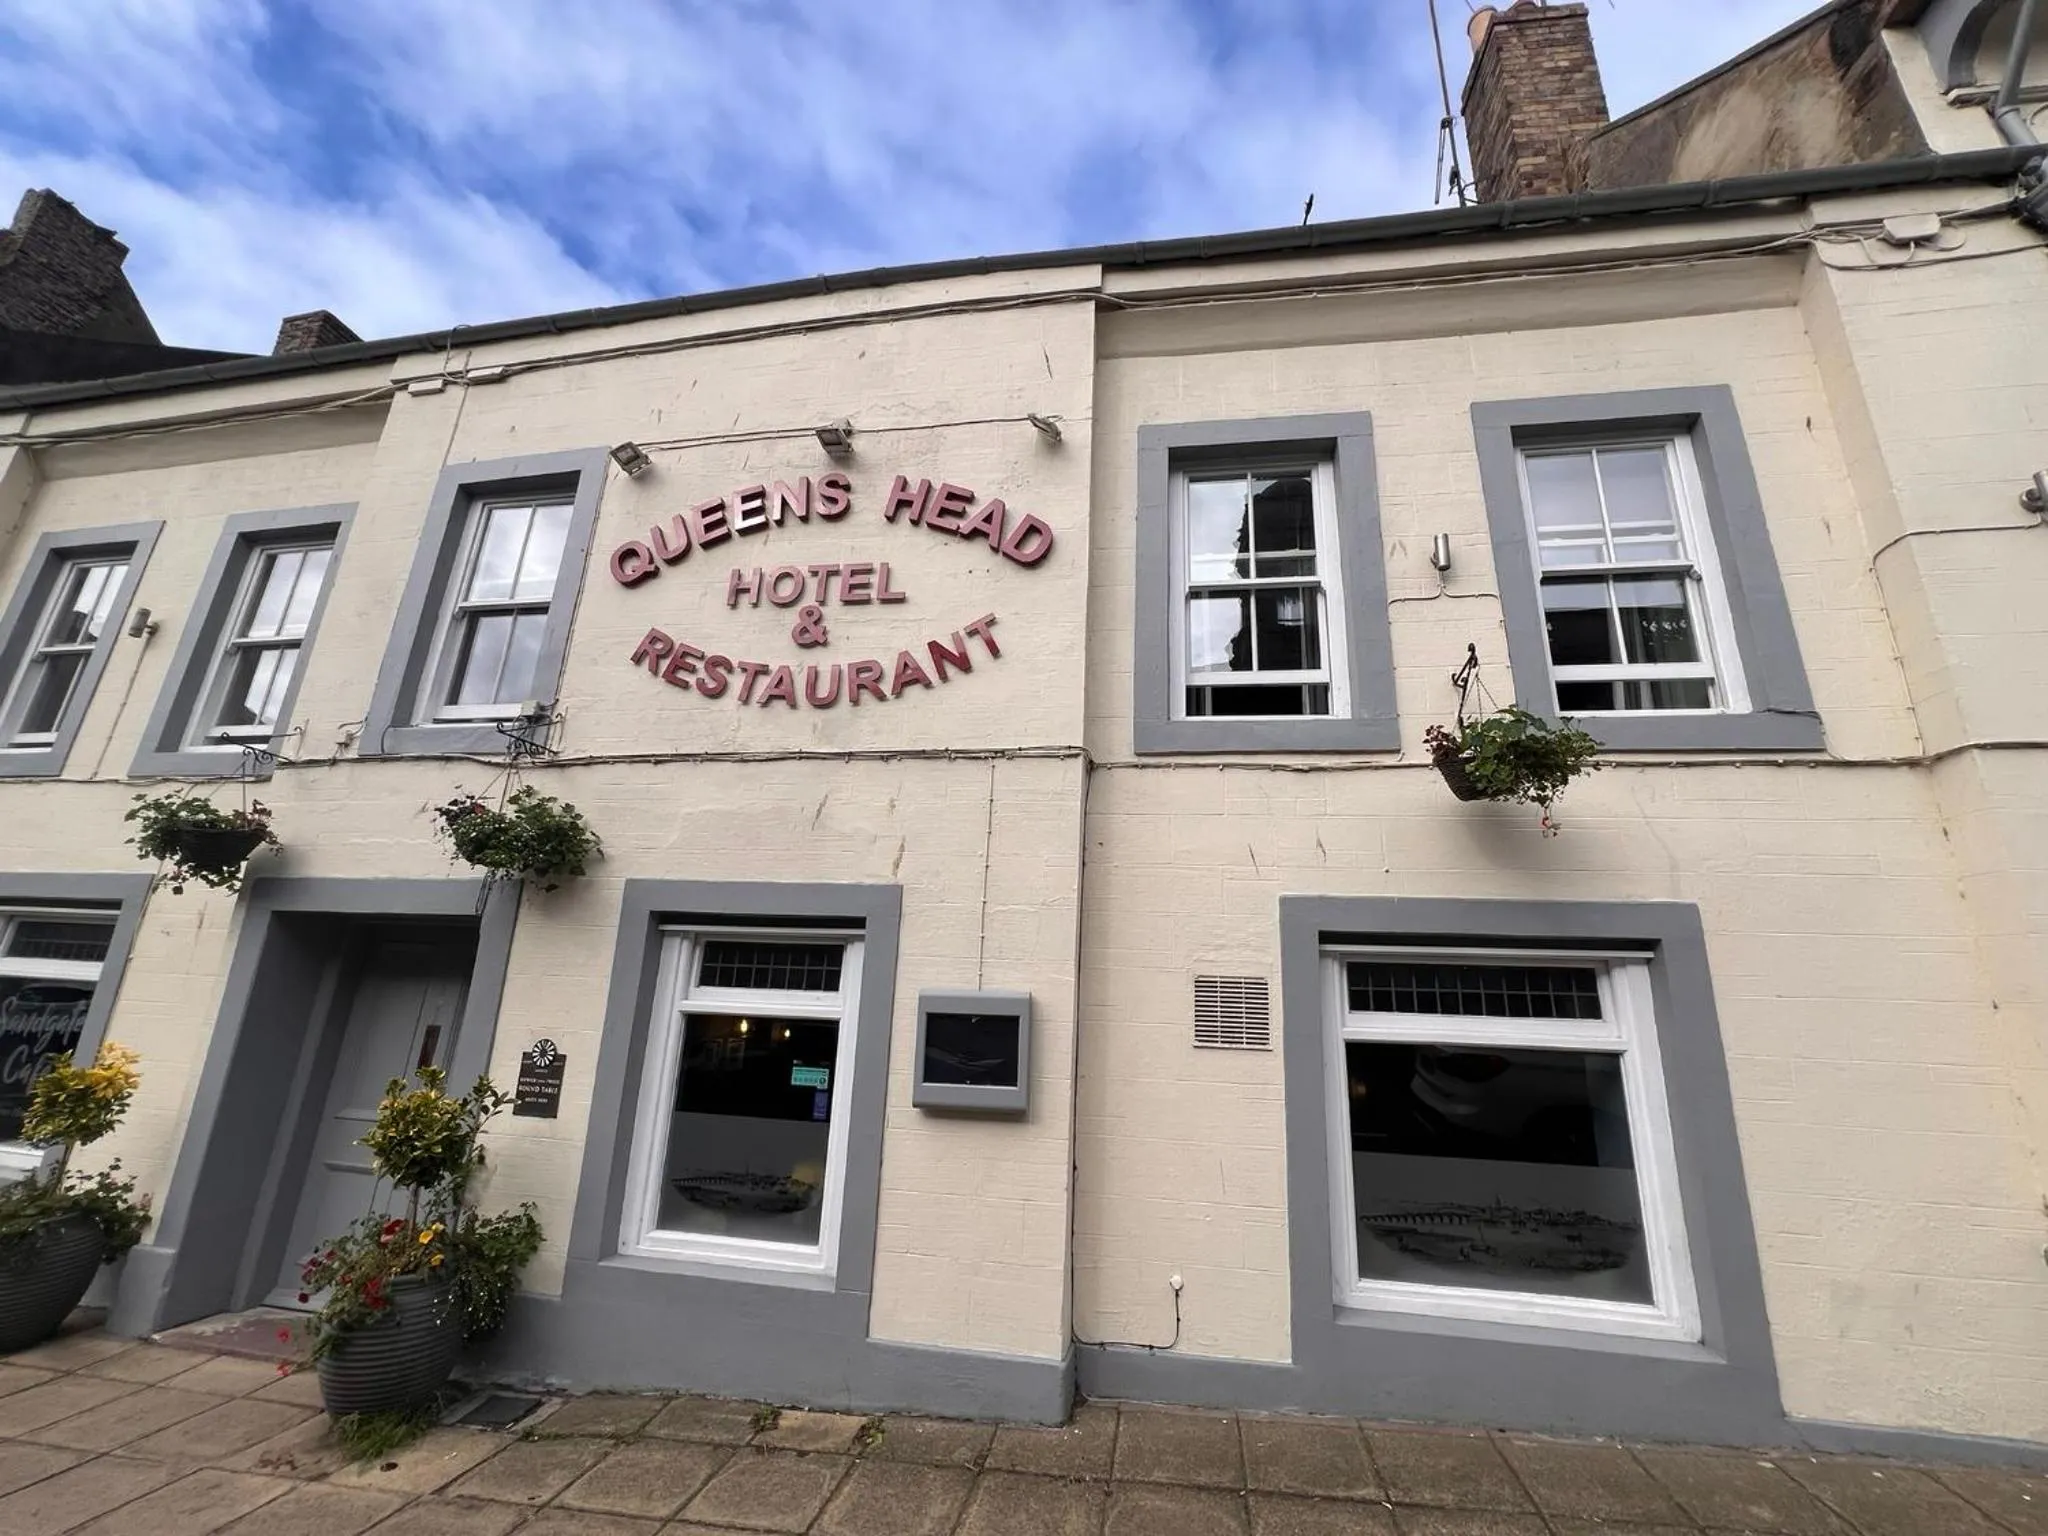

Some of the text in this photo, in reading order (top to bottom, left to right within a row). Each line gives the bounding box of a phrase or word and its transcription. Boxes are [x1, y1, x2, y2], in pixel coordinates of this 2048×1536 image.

[610, 473, 1054, 587] QUEENS HEAD
[727, 562, 906, 607] HOTEL
[630, 612, 1002, 708] RESTAURANT
[791, 604, 829, 649] &
